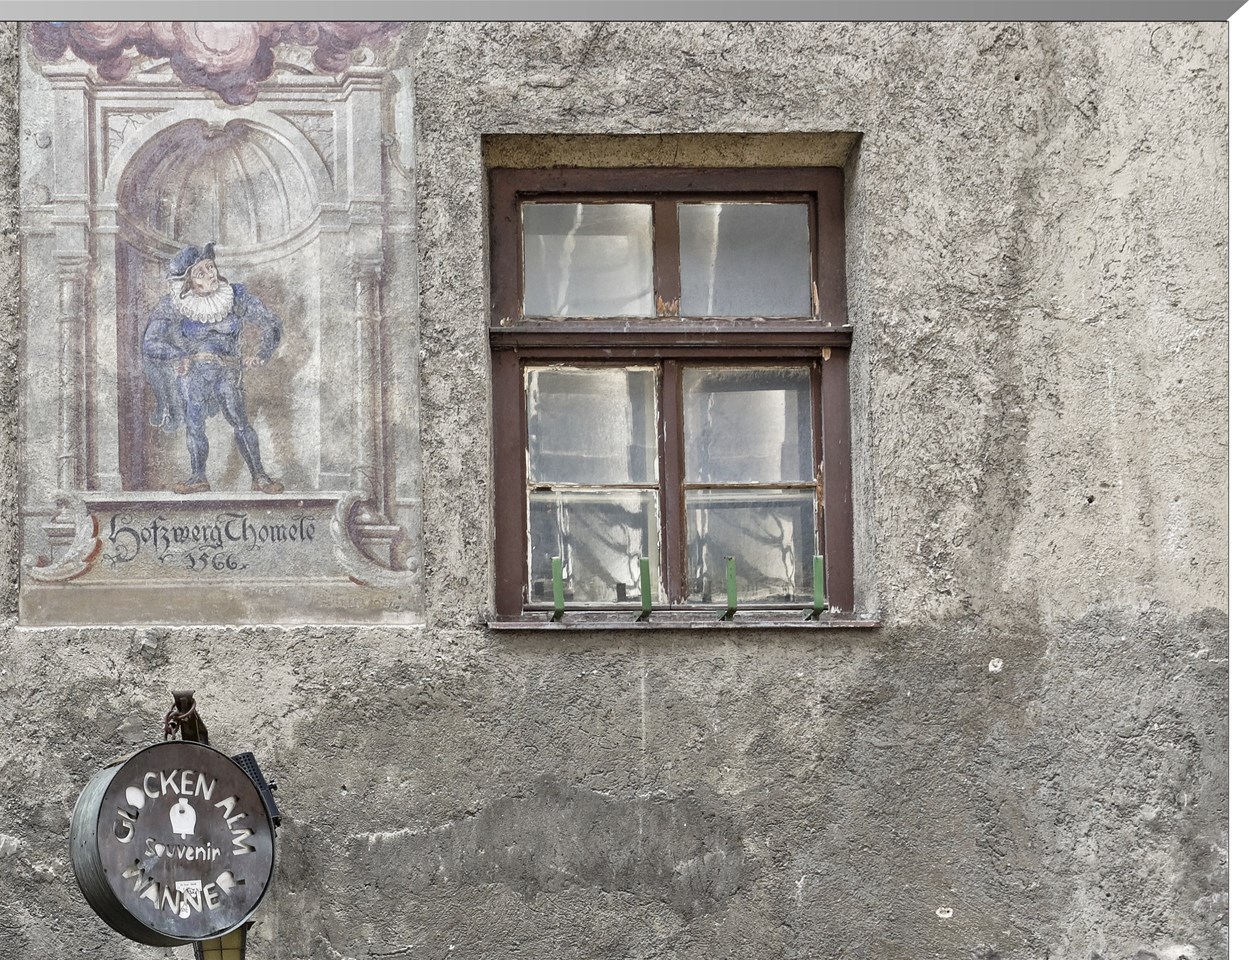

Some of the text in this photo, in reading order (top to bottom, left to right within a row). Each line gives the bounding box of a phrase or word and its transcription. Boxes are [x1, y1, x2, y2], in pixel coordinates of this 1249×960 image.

[113, 769, 256, 856] GLOCKEN ALM
[145, 837, 221, 861] Souvenir
